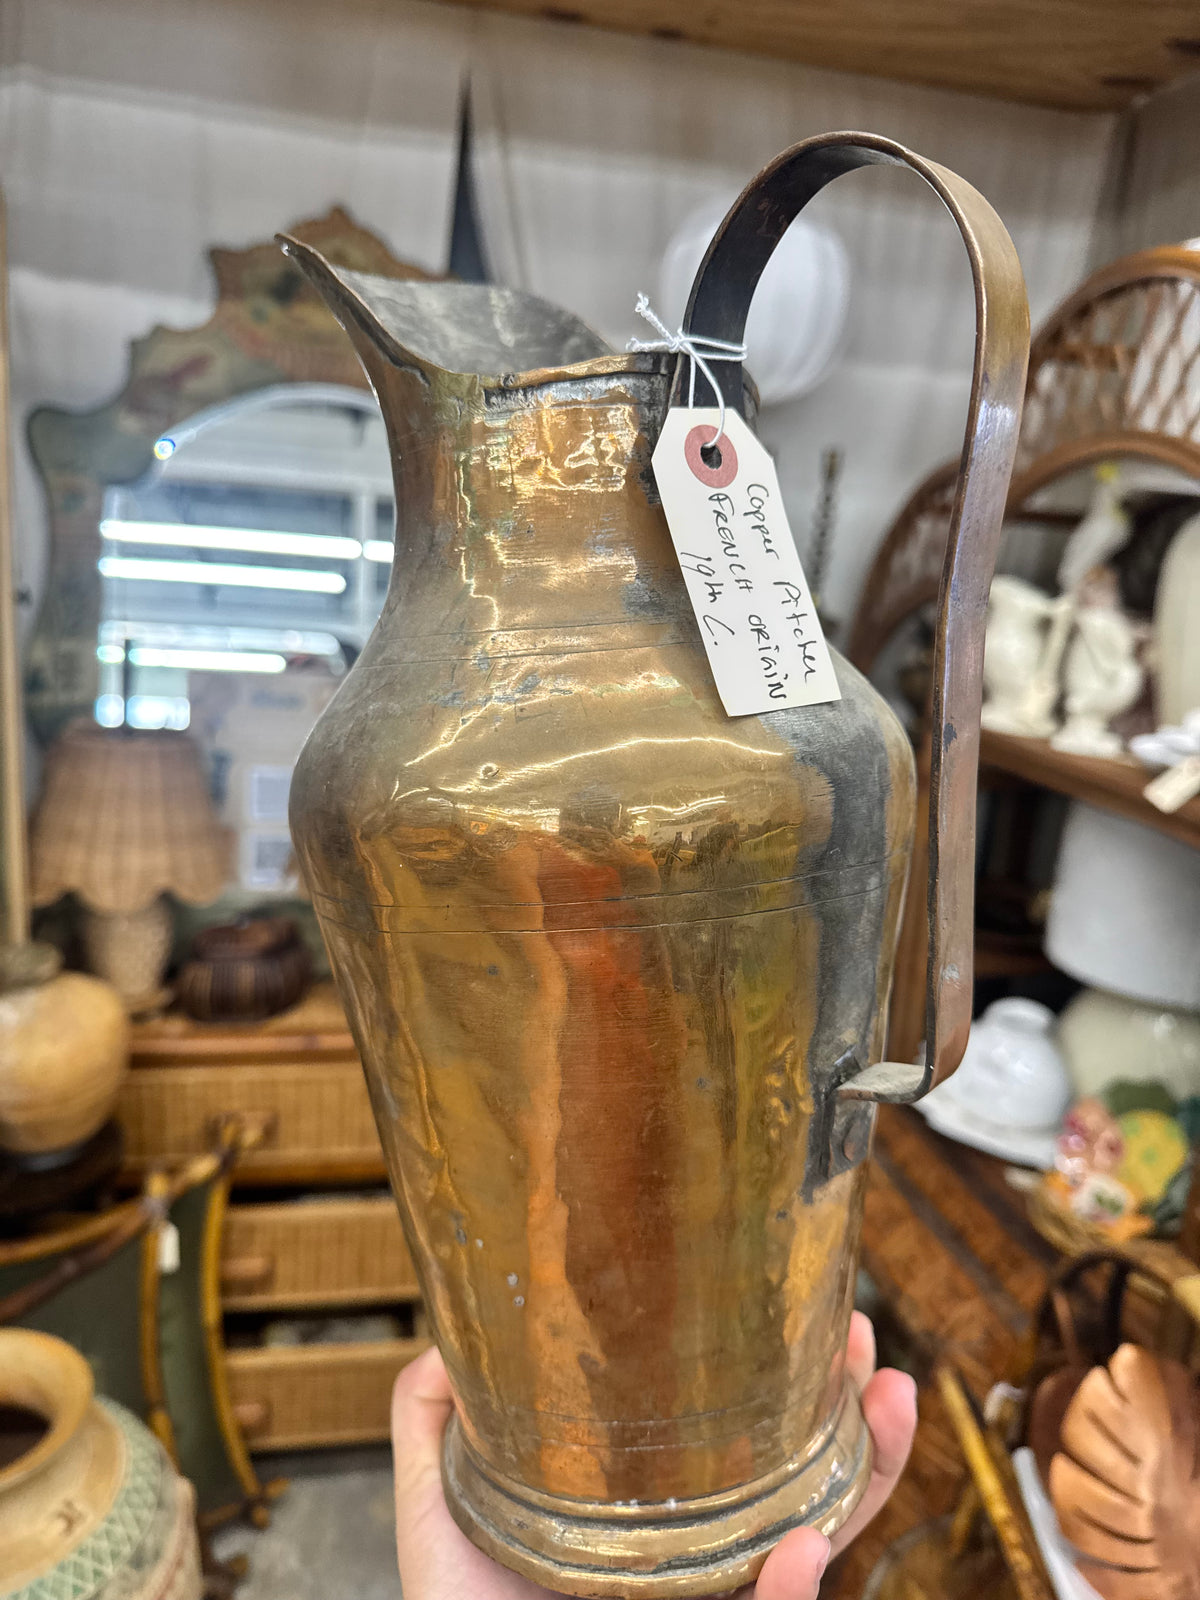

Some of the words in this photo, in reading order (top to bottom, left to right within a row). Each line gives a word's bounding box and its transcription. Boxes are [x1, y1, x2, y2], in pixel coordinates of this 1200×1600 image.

[708, 492, 753, 593] FRENCH
[742, 483, 779, 560] Copper
[773, 581, 817, 683] Pitcher
[680, 551, 724, 603] 19th
[703, 614, 735, 646] C.
